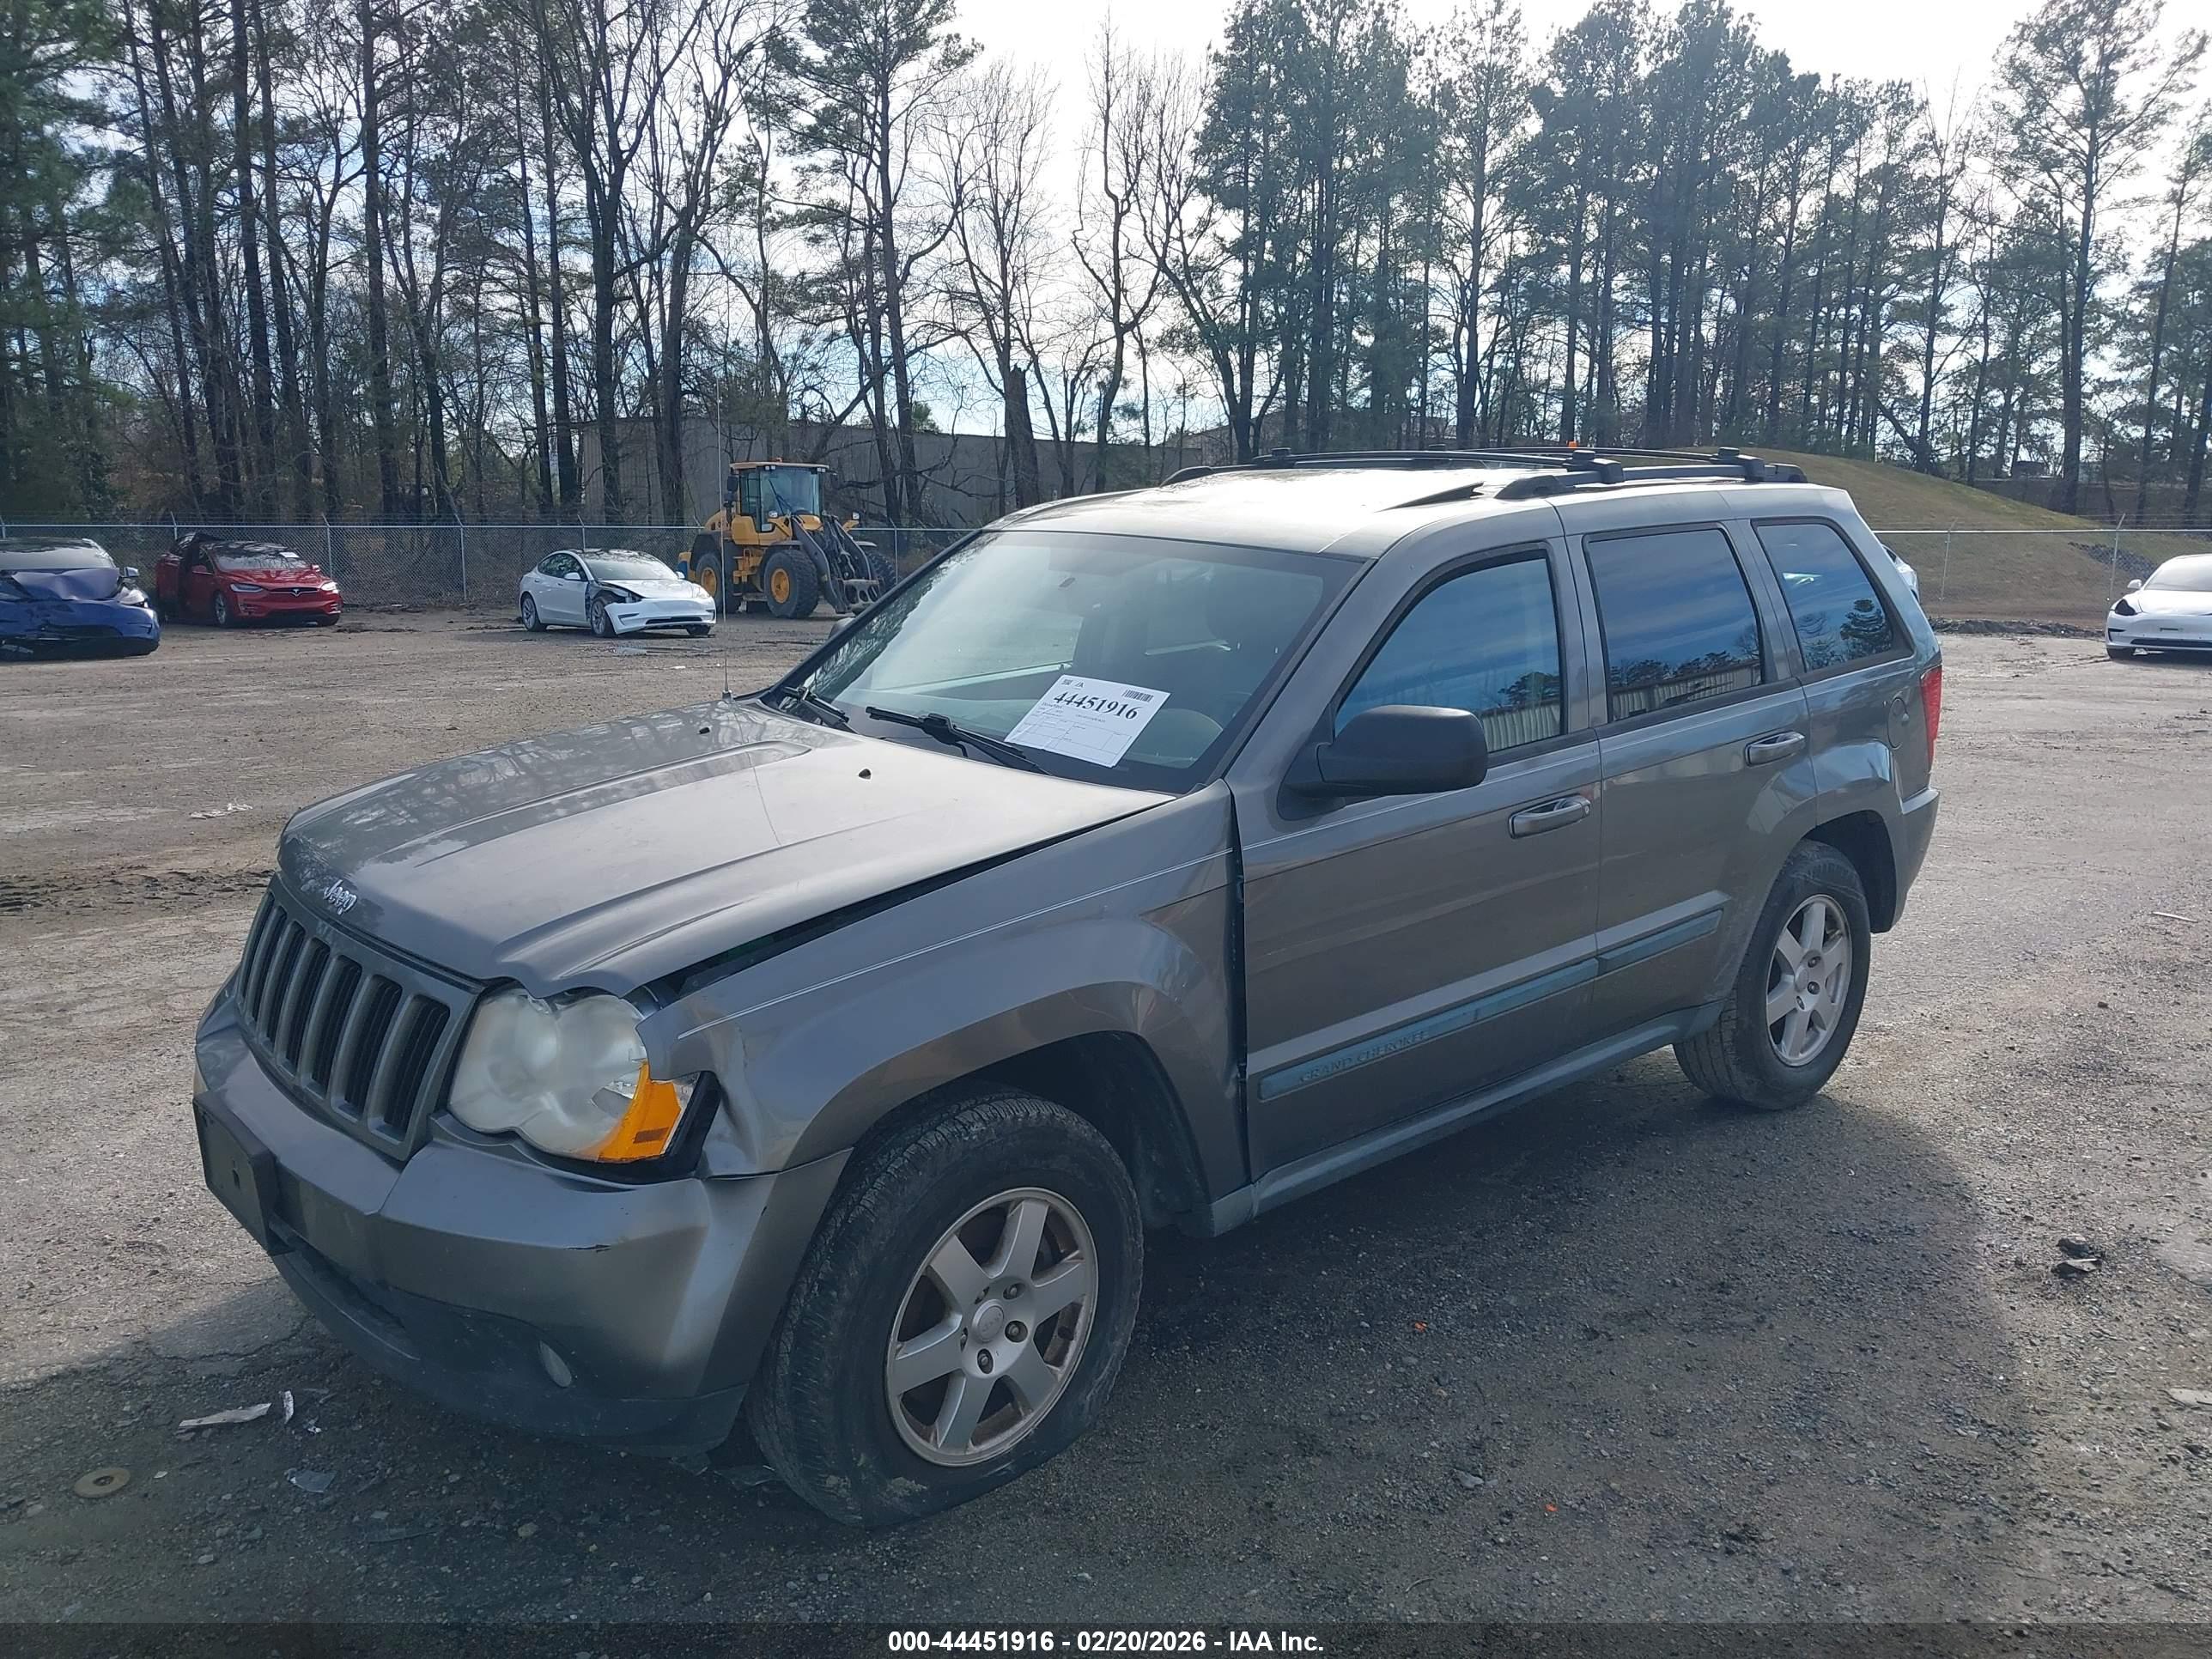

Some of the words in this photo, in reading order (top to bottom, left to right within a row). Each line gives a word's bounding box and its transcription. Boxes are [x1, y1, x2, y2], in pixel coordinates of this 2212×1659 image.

[1054, 691, 1143, 720] 44451916
[323, 879, 357, 915] Jeep
[1298, 1056, 1354, 1083] GRAND
[1358, 1030, 1430, 1062] CHEROKEE
